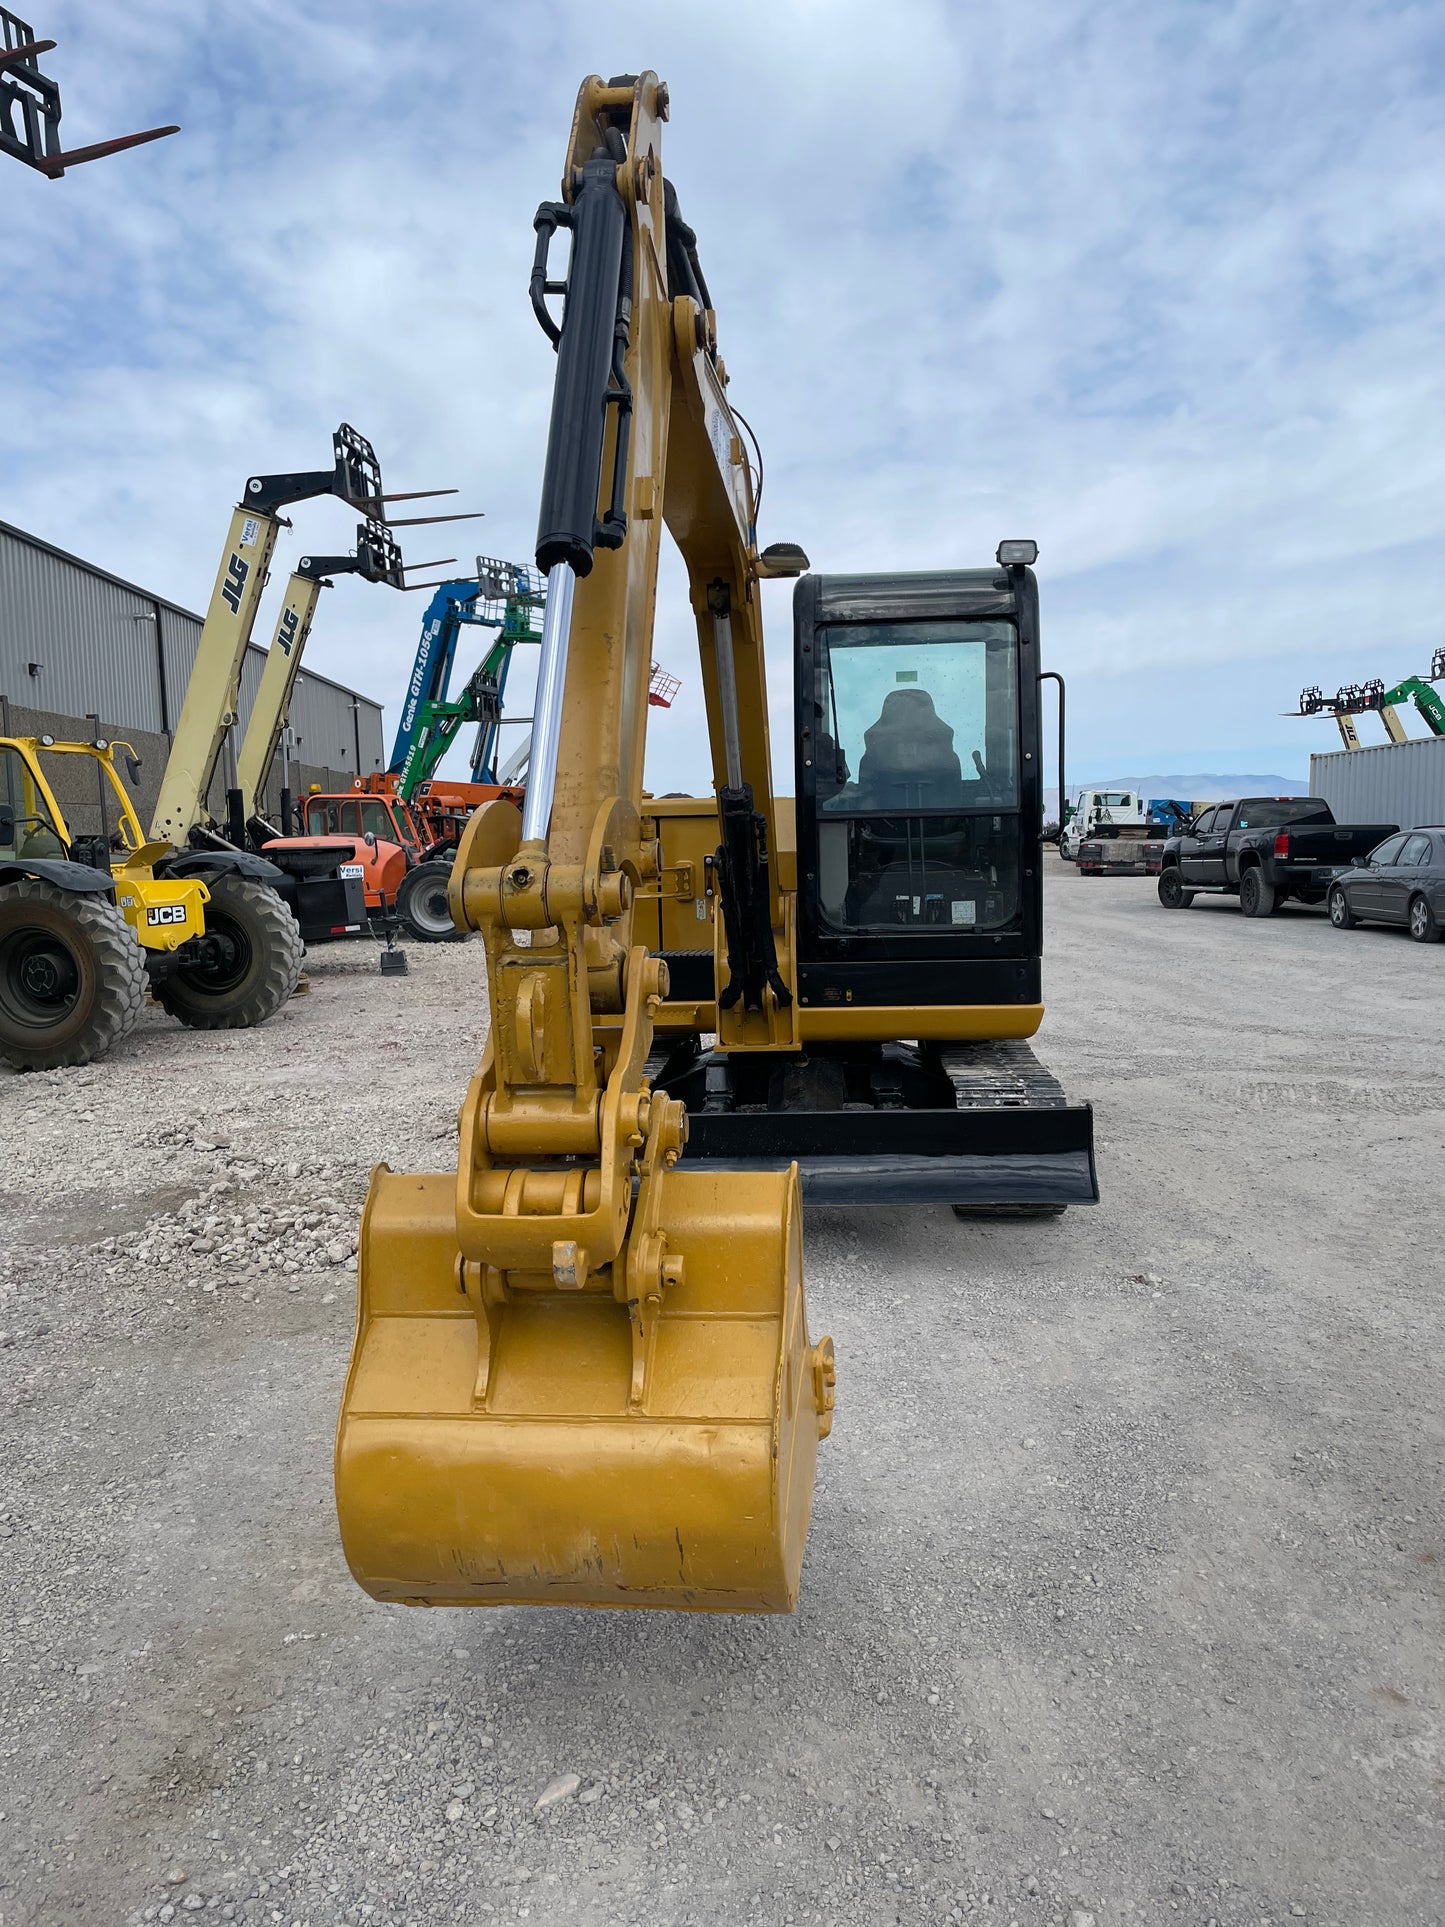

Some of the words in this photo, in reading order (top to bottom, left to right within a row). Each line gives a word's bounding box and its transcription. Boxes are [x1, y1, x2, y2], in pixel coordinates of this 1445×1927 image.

[242, 519, 253, 542] Versi
[222, 552, 250, 615] JLG
[277, 607, 300, 657] JLG
[402, 698, 418, 732] Genie
[411, 630, 433, 697] GTH-1056
[1428, 704, 1442, 720] JCB
[1345, 724, 1357, 741] JLG
[400, 744, 417, 784] GTH-5519
[148, 906, 186, 925] JCB
